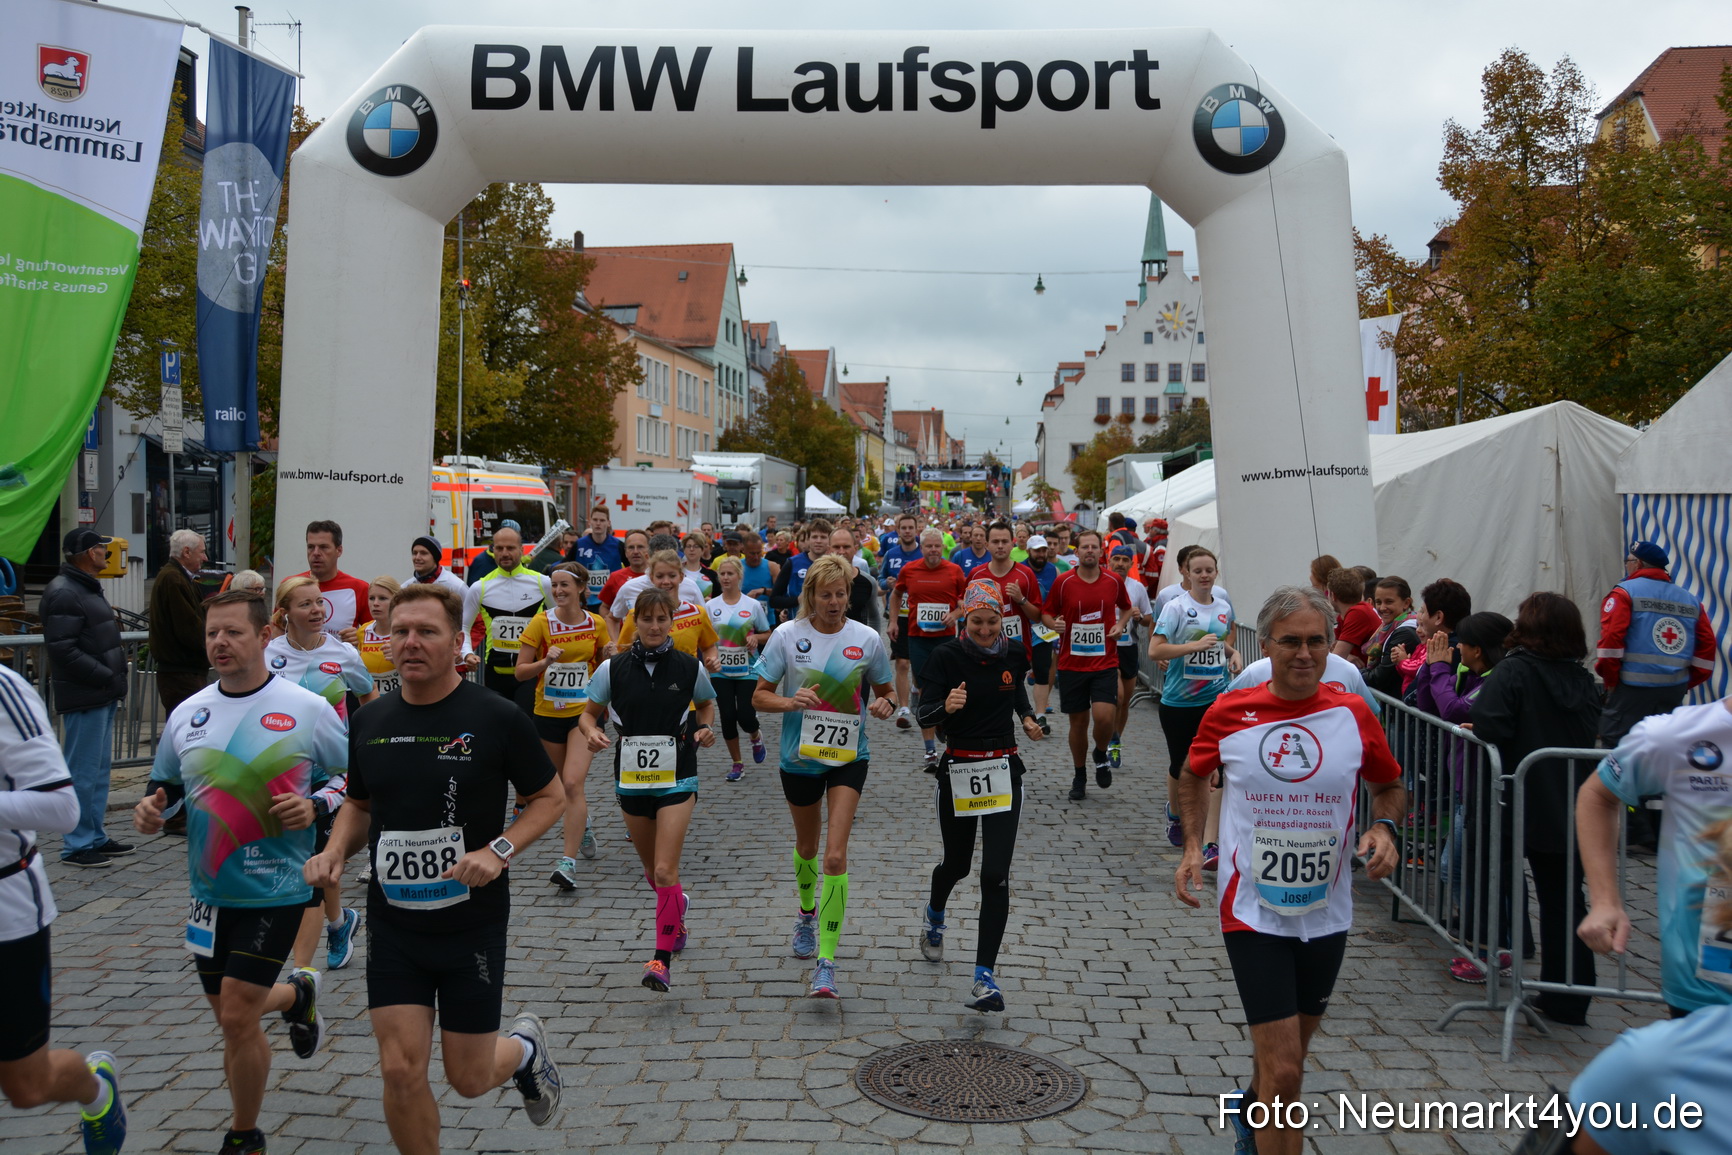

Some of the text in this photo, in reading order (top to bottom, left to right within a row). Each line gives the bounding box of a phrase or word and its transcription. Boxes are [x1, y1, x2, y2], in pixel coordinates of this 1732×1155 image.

[470, 43, 1162, 129] BMW Laufsport
[358, 86, 431, 116] BMW
[1200, 85, 1275, 114] BMW
[279, 468, 404, 485] www.bmw-laufsport.de
[1241, 464, 1369, 483] www.bmw-laufsport.de
[635, 494, 669, 502] Bayerisches
[578, 547, 593, 558] 14
[888, 558, 903, 569] 12
[964, 560, 972, 568] 5
[1640, 600, 1676, 612] TECHNISCHER
[676, 618, 702, 632] BÖGL
[551, 633, 597, 645] MAX BÖGL
[1074, 631, 1102, 644] 2406
[720, 653, 746, 666] 2565
[1189, 650, 1221, 665] 2051
[548, 671, 585, 687] 2707
[265, 716, 293, 728] Hervis
[804, 714, 852, 726] PARTL Neumarkt
[187, 729, 208, 738] PARTL
[390, 736, 416, 744] ROTHSEE
[812, 723, 850, 747] 273
[637, 748, 660, 769] 62
[818, 749, 839, 759] Heidi
[971, 765, 1000, 774] Neumarkt
[635, 773, 660, 782] Kerstin
[1689, 776, 1728, 786] PARTL
[969, 773, 992, 796] 61
[968, 798, 998, 809] Annette
[1245, 790, 1342, 804] LAUFEN MIT HERZ
[1252, 807, 1263, 815] Dr.
[1264, 807, 1285, 816] Heck
[1292, 808, 1305, 816] Dr.
[1306, 807, 1333, 817] Röschl
[379, 835, 448, 848] PARTL Neumarkt
[1255, 836, 1327, 849] PARTL Neumarkt
[243, 846, 264, 858] 16.
[385, 846, 458, 882] 2688
[1261, 850, 1331, 884] 2055
[400, 885, 448, 900] Manfred
[1280, 890, 1312, 904] Josef
